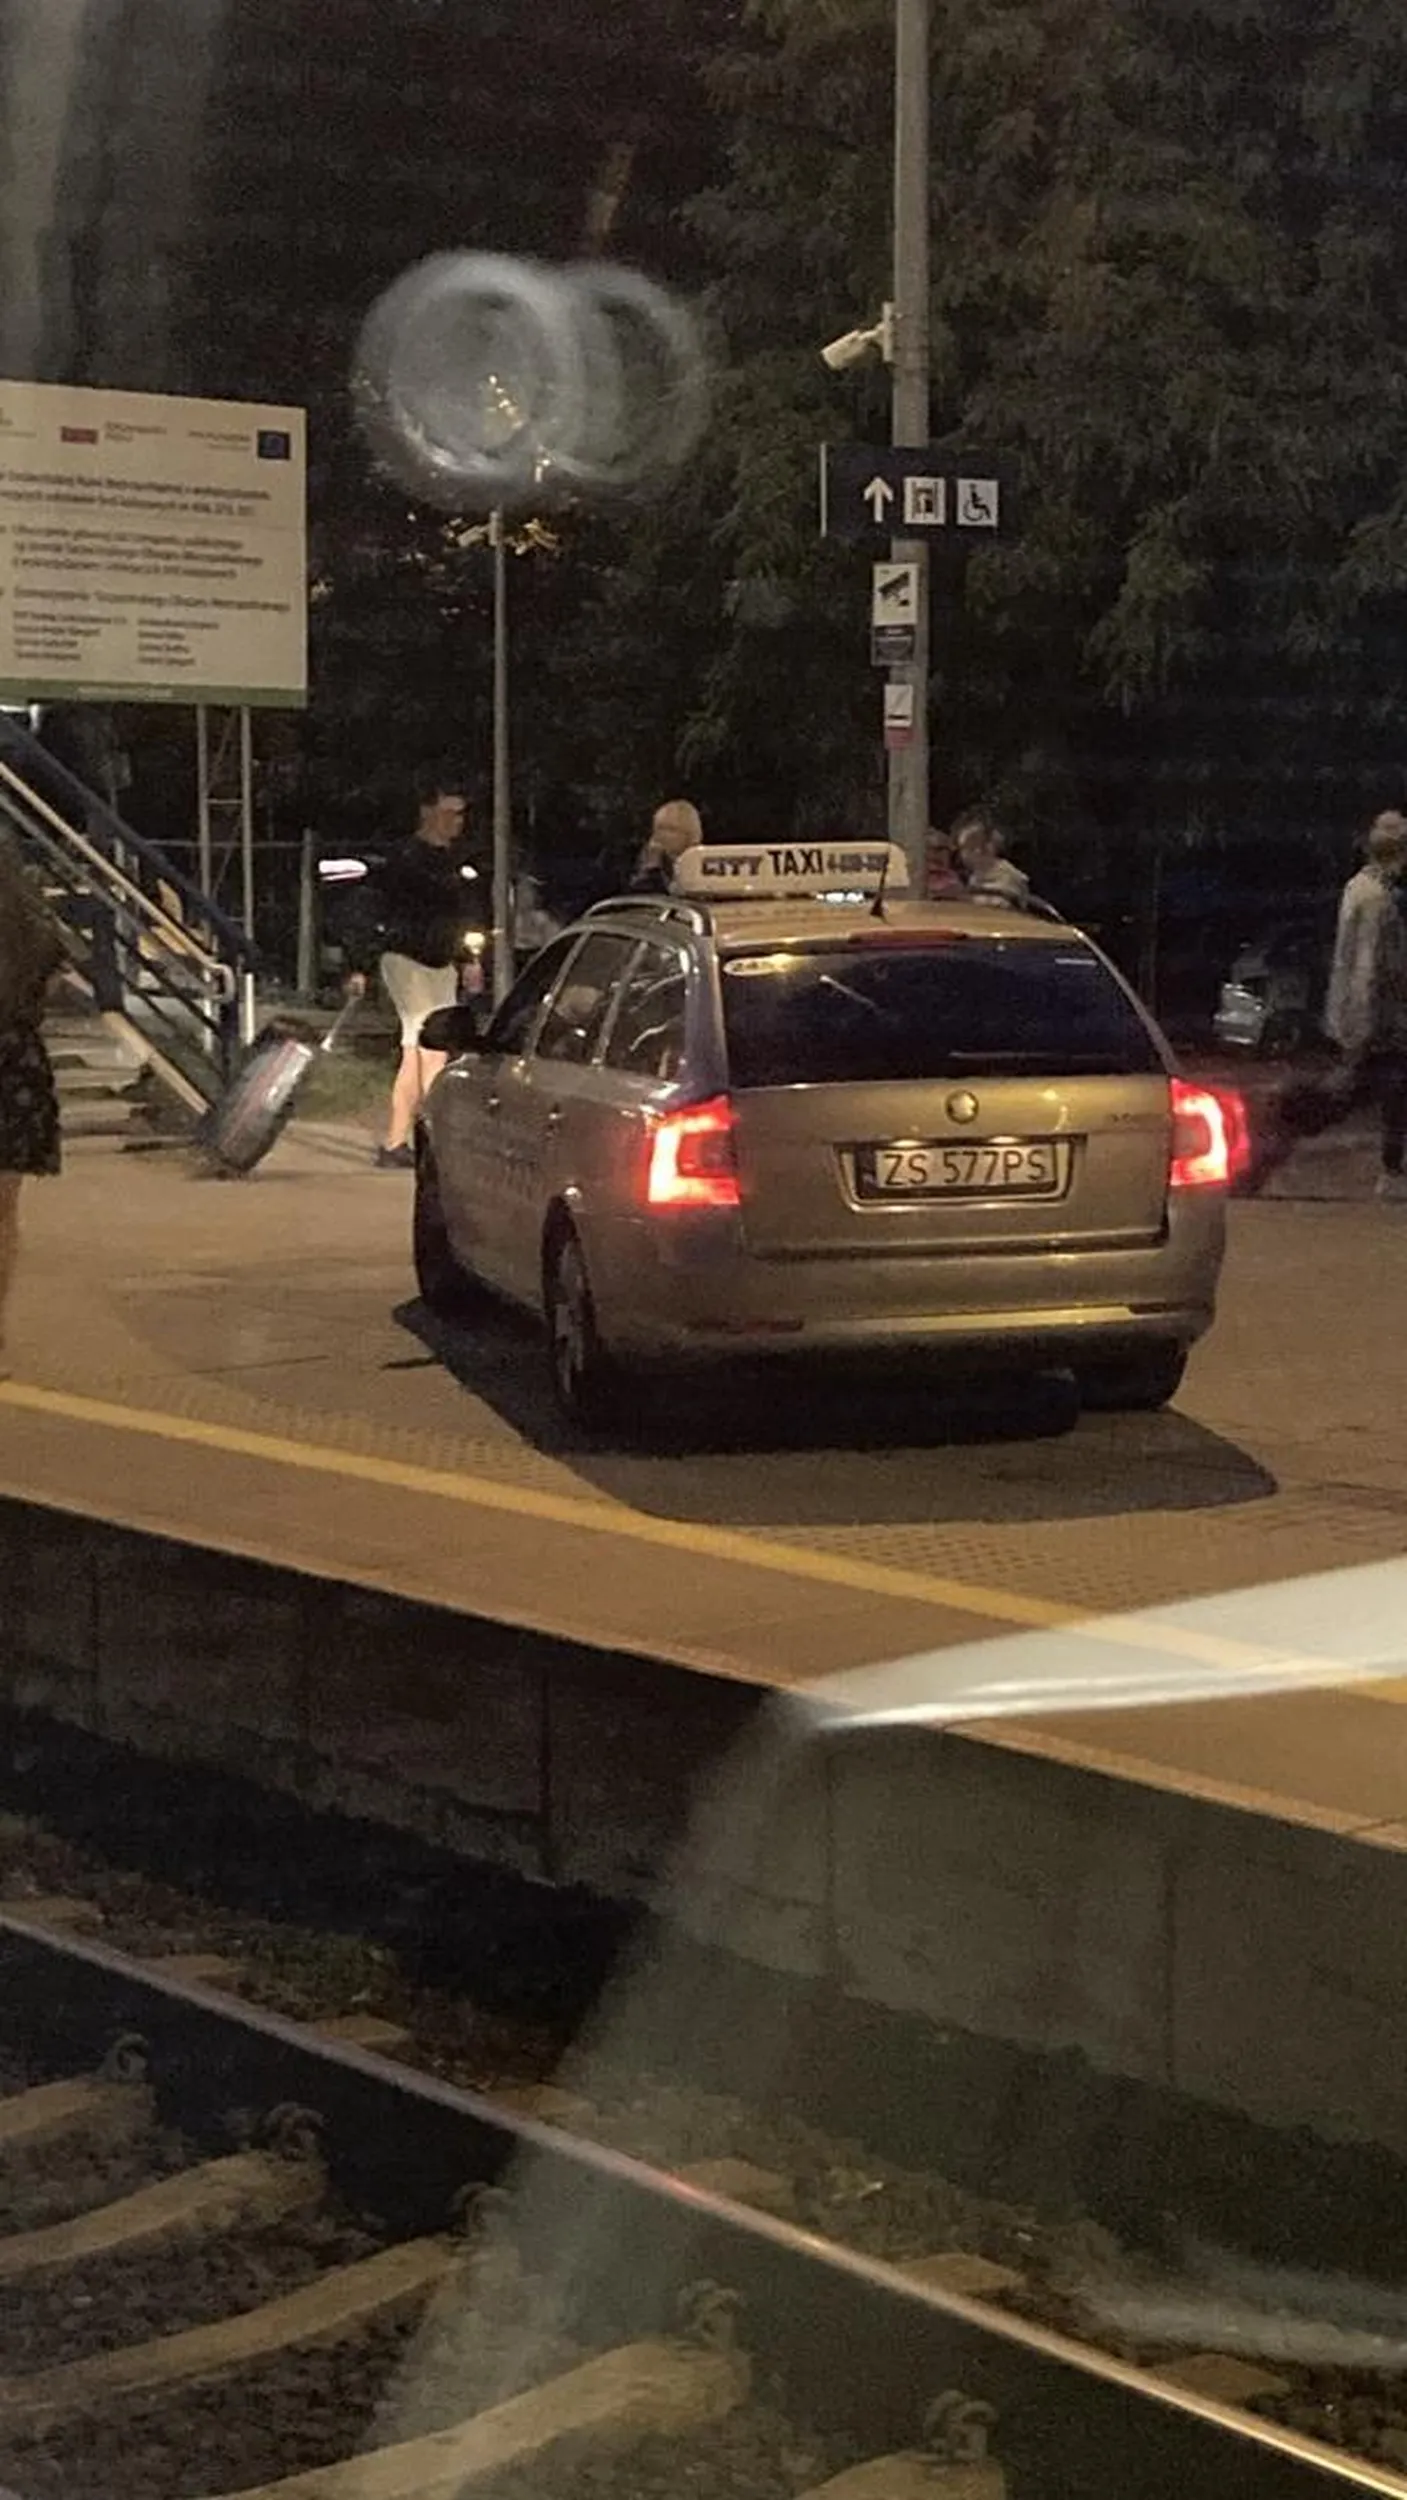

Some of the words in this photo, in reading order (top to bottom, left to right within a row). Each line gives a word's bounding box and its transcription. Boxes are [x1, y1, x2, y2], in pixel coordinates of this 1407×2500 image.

[702, 855, 762, 877] CITY
[768, 848, 823, 876] TAXI
[884, 1153, 927, 1186] ZS
[943, 1149, 1046, 1184] 577PS
